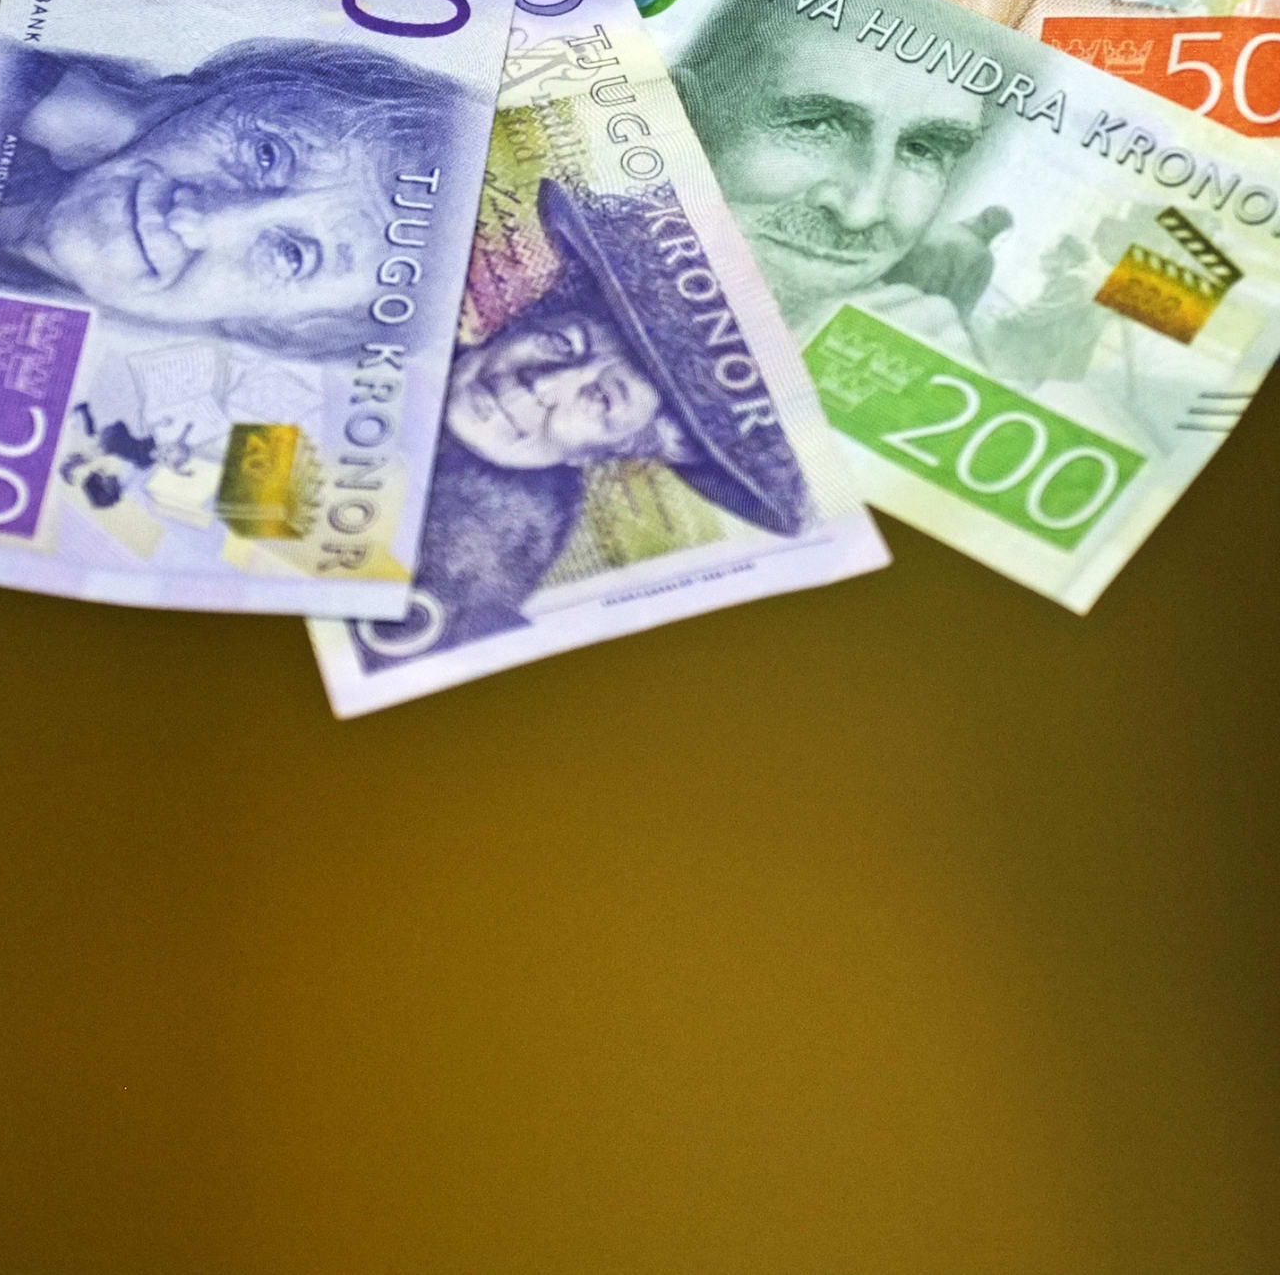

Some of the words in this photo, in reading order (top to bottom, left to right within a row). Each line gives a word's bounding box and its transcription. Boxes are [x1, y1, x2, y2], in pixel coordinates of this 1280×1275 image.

[856, 8, 1068, 133] HUNDRA
[370, 167, 440, 325] TJUGO
[567, 24, 665, 181] TJUGO
[645, 204, 778, 435] KRONOR
[317, 342, 405, 572] KRONOR
[880, 373, 1116, 533] 200
